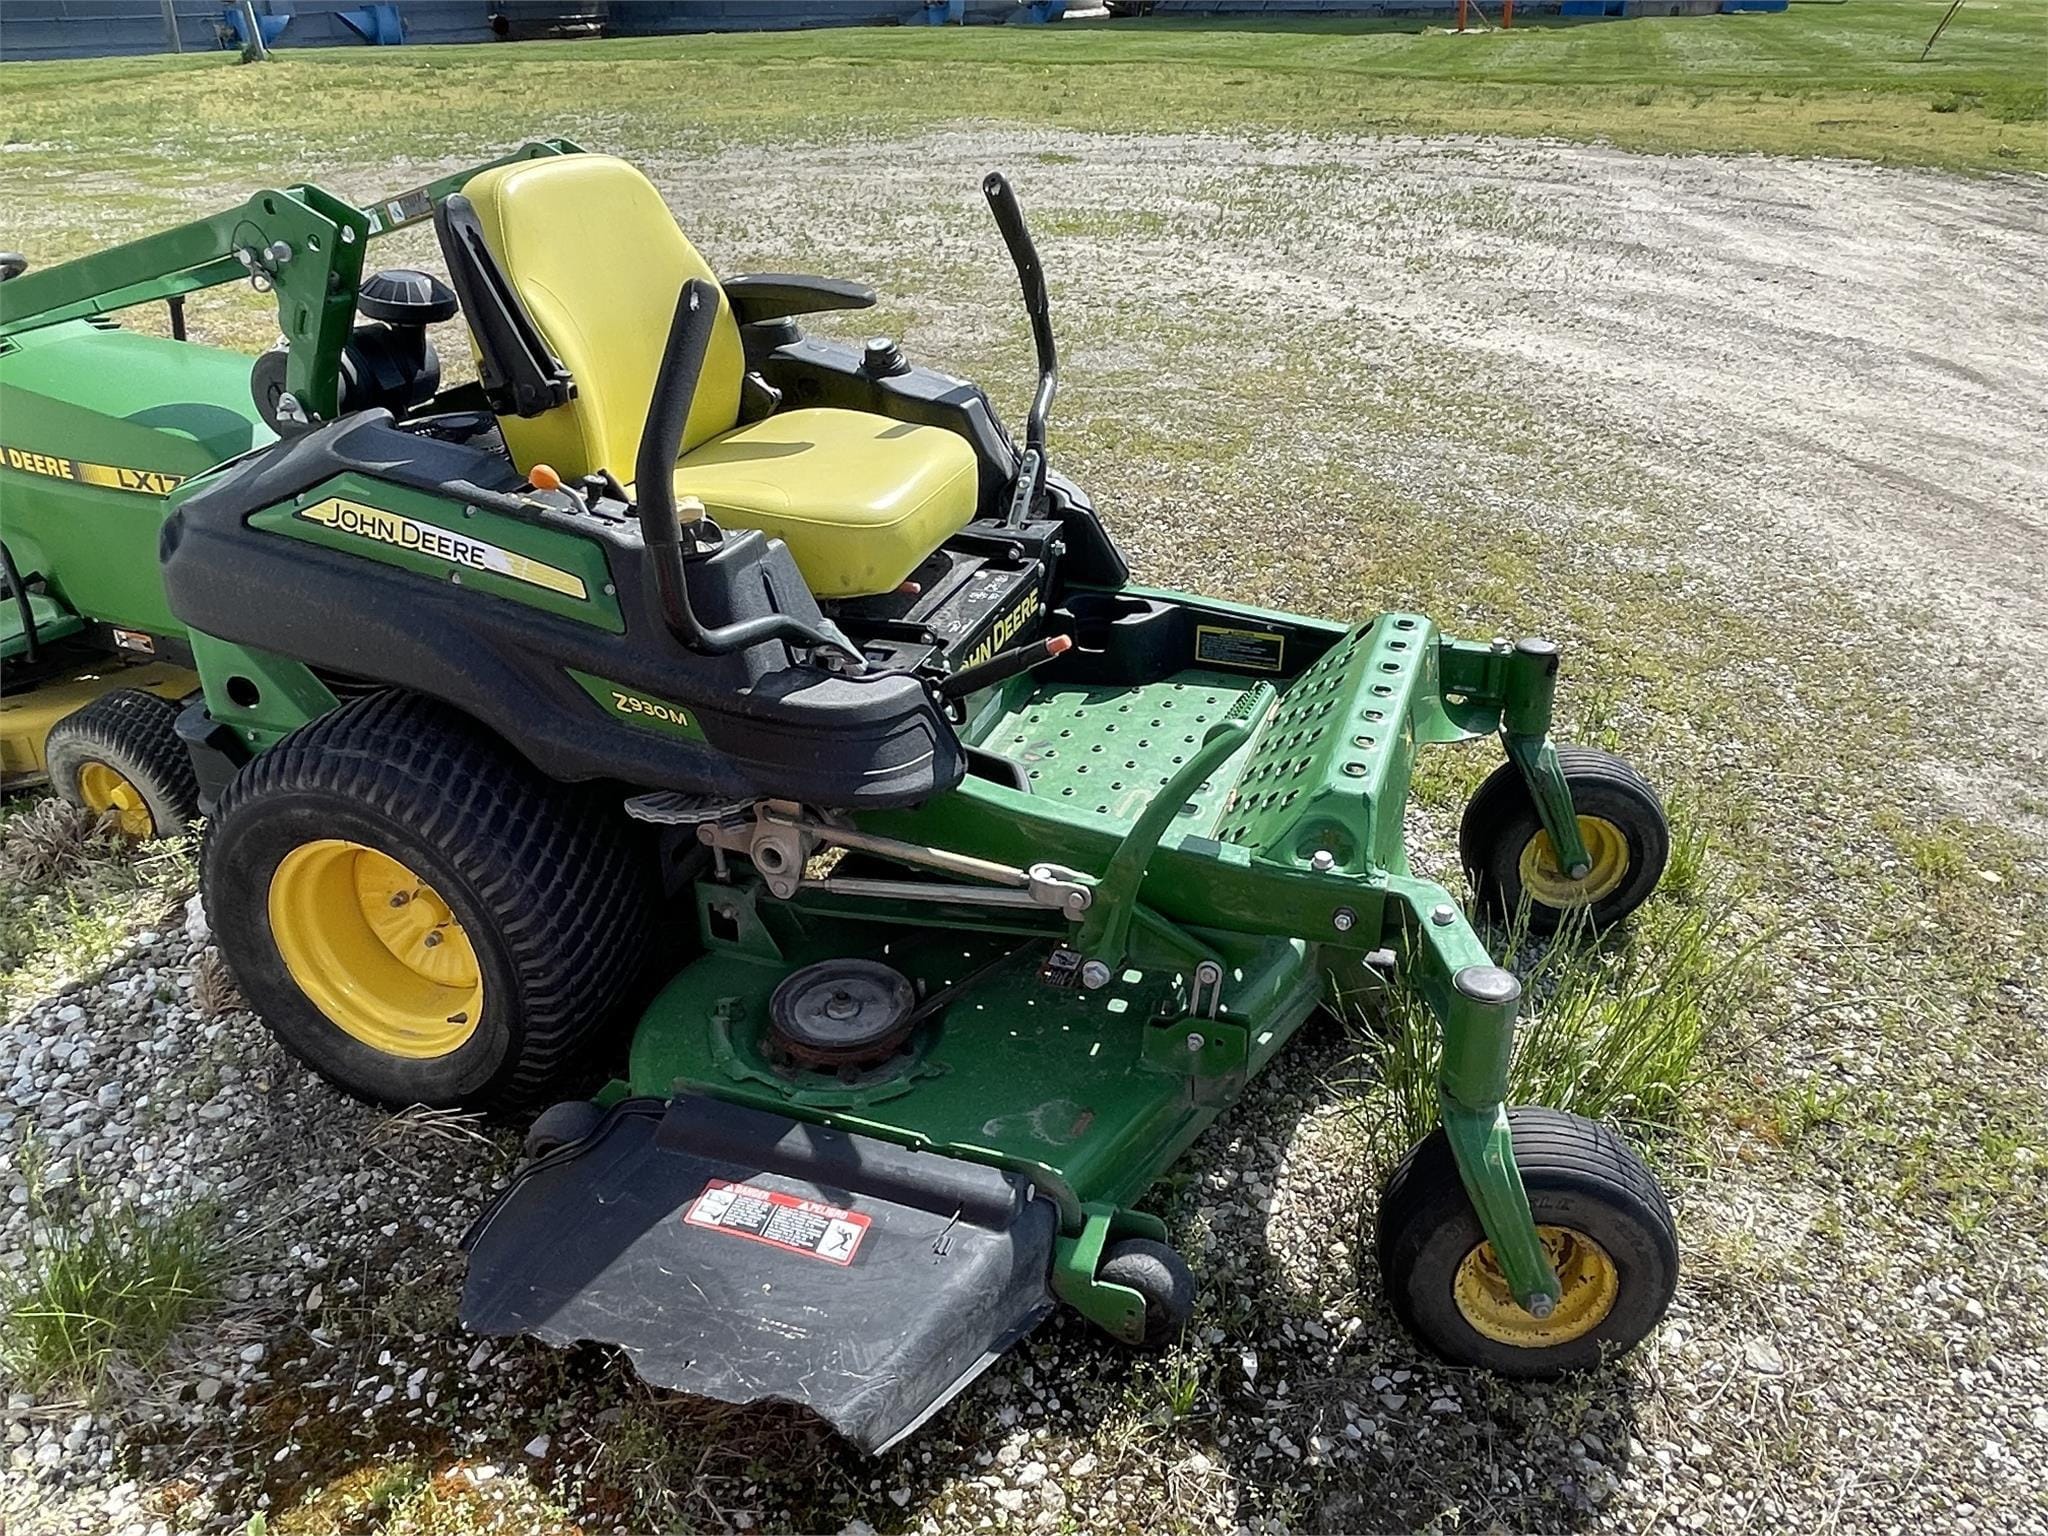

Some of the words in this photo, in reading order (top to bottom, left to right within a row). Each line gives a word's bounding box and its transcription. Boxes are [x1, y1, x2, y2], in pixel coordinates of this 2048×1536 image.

[8, 448, 74, 480] DEERE
[117, 469, 187, 493] LX17
[327, 503, 395, 540] JOHN
[401, 521, 485, 566] DEERE
[993, 587, 1039, 652] DEERE
[611, 691, 689, 726] Z930M
